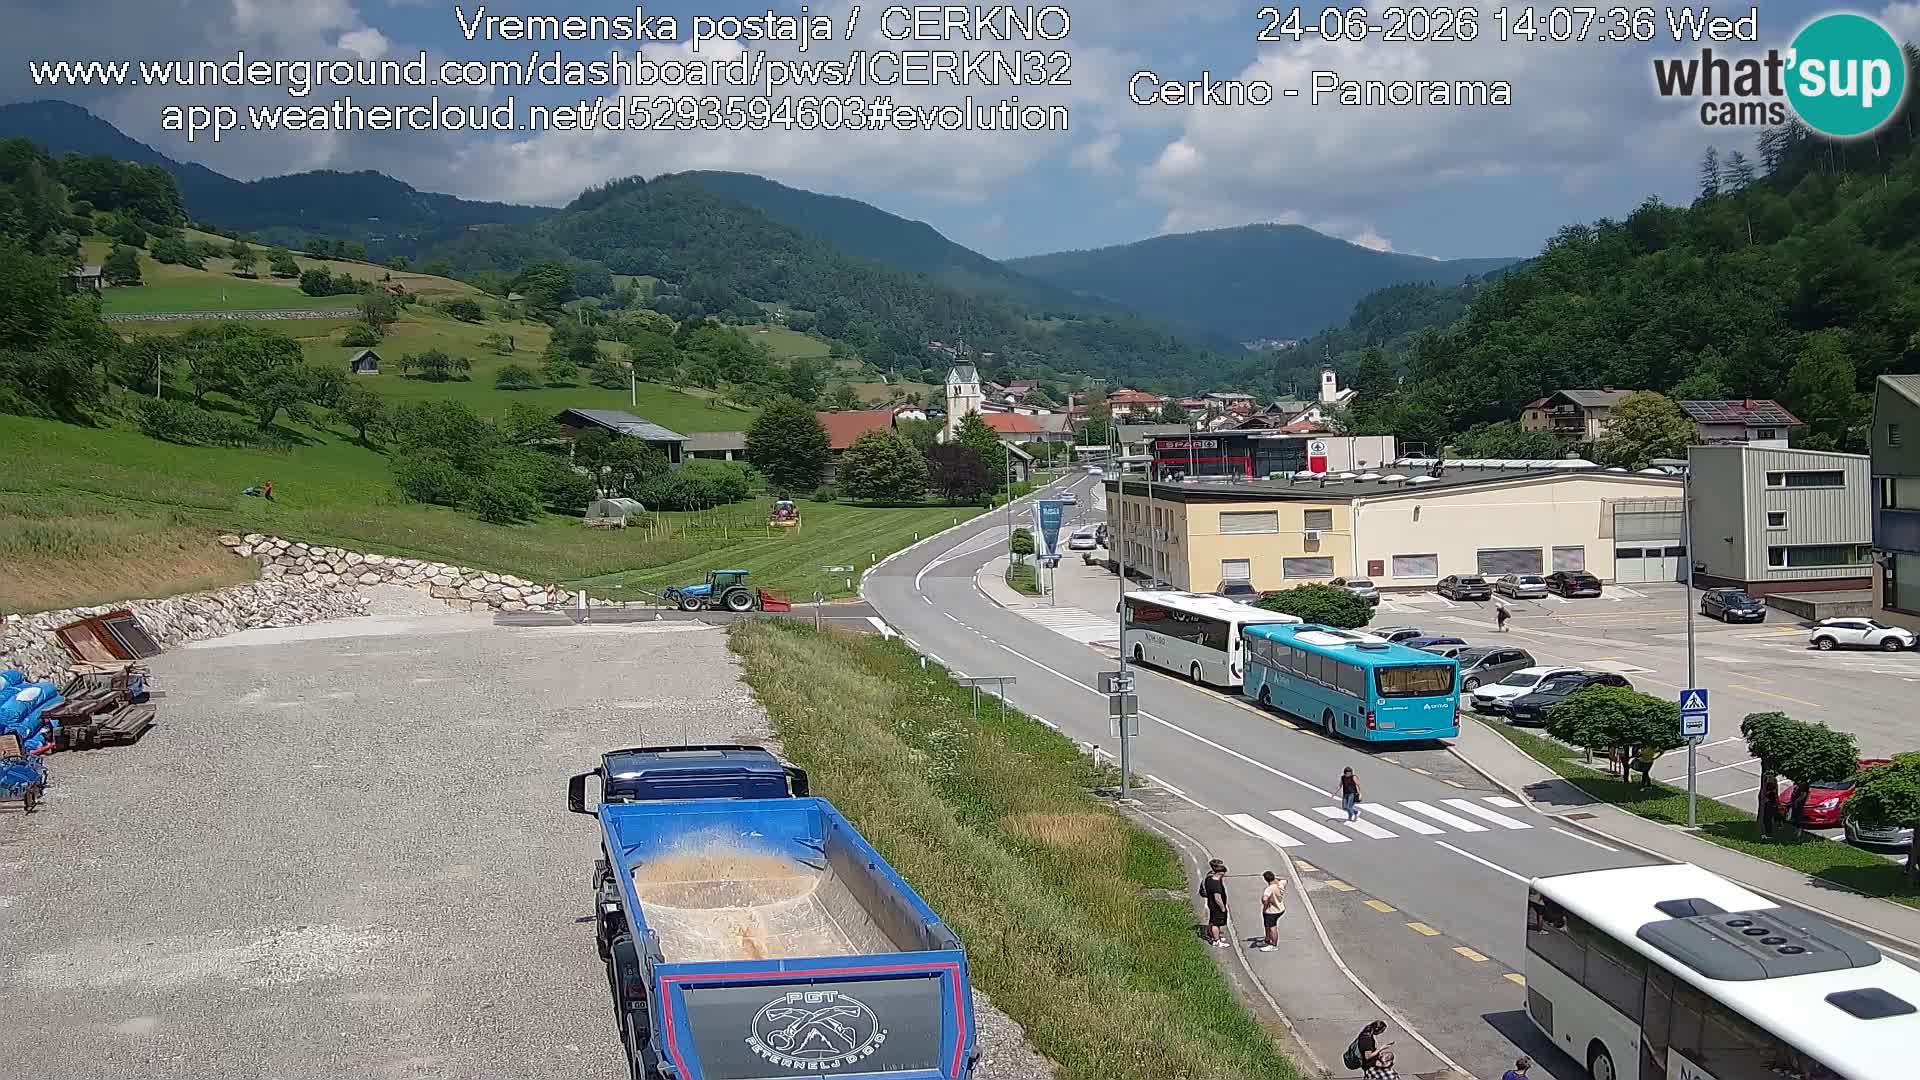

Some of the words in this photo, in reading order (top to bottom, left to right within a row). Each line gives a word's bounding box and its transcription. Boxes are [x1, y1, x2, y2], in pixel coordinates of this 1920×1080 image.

[1165, 440, 1202, 449] SPAR
[785, 990, 839, 1005] PGT
[744, 1035, 841, 1070] PETERNELJ
